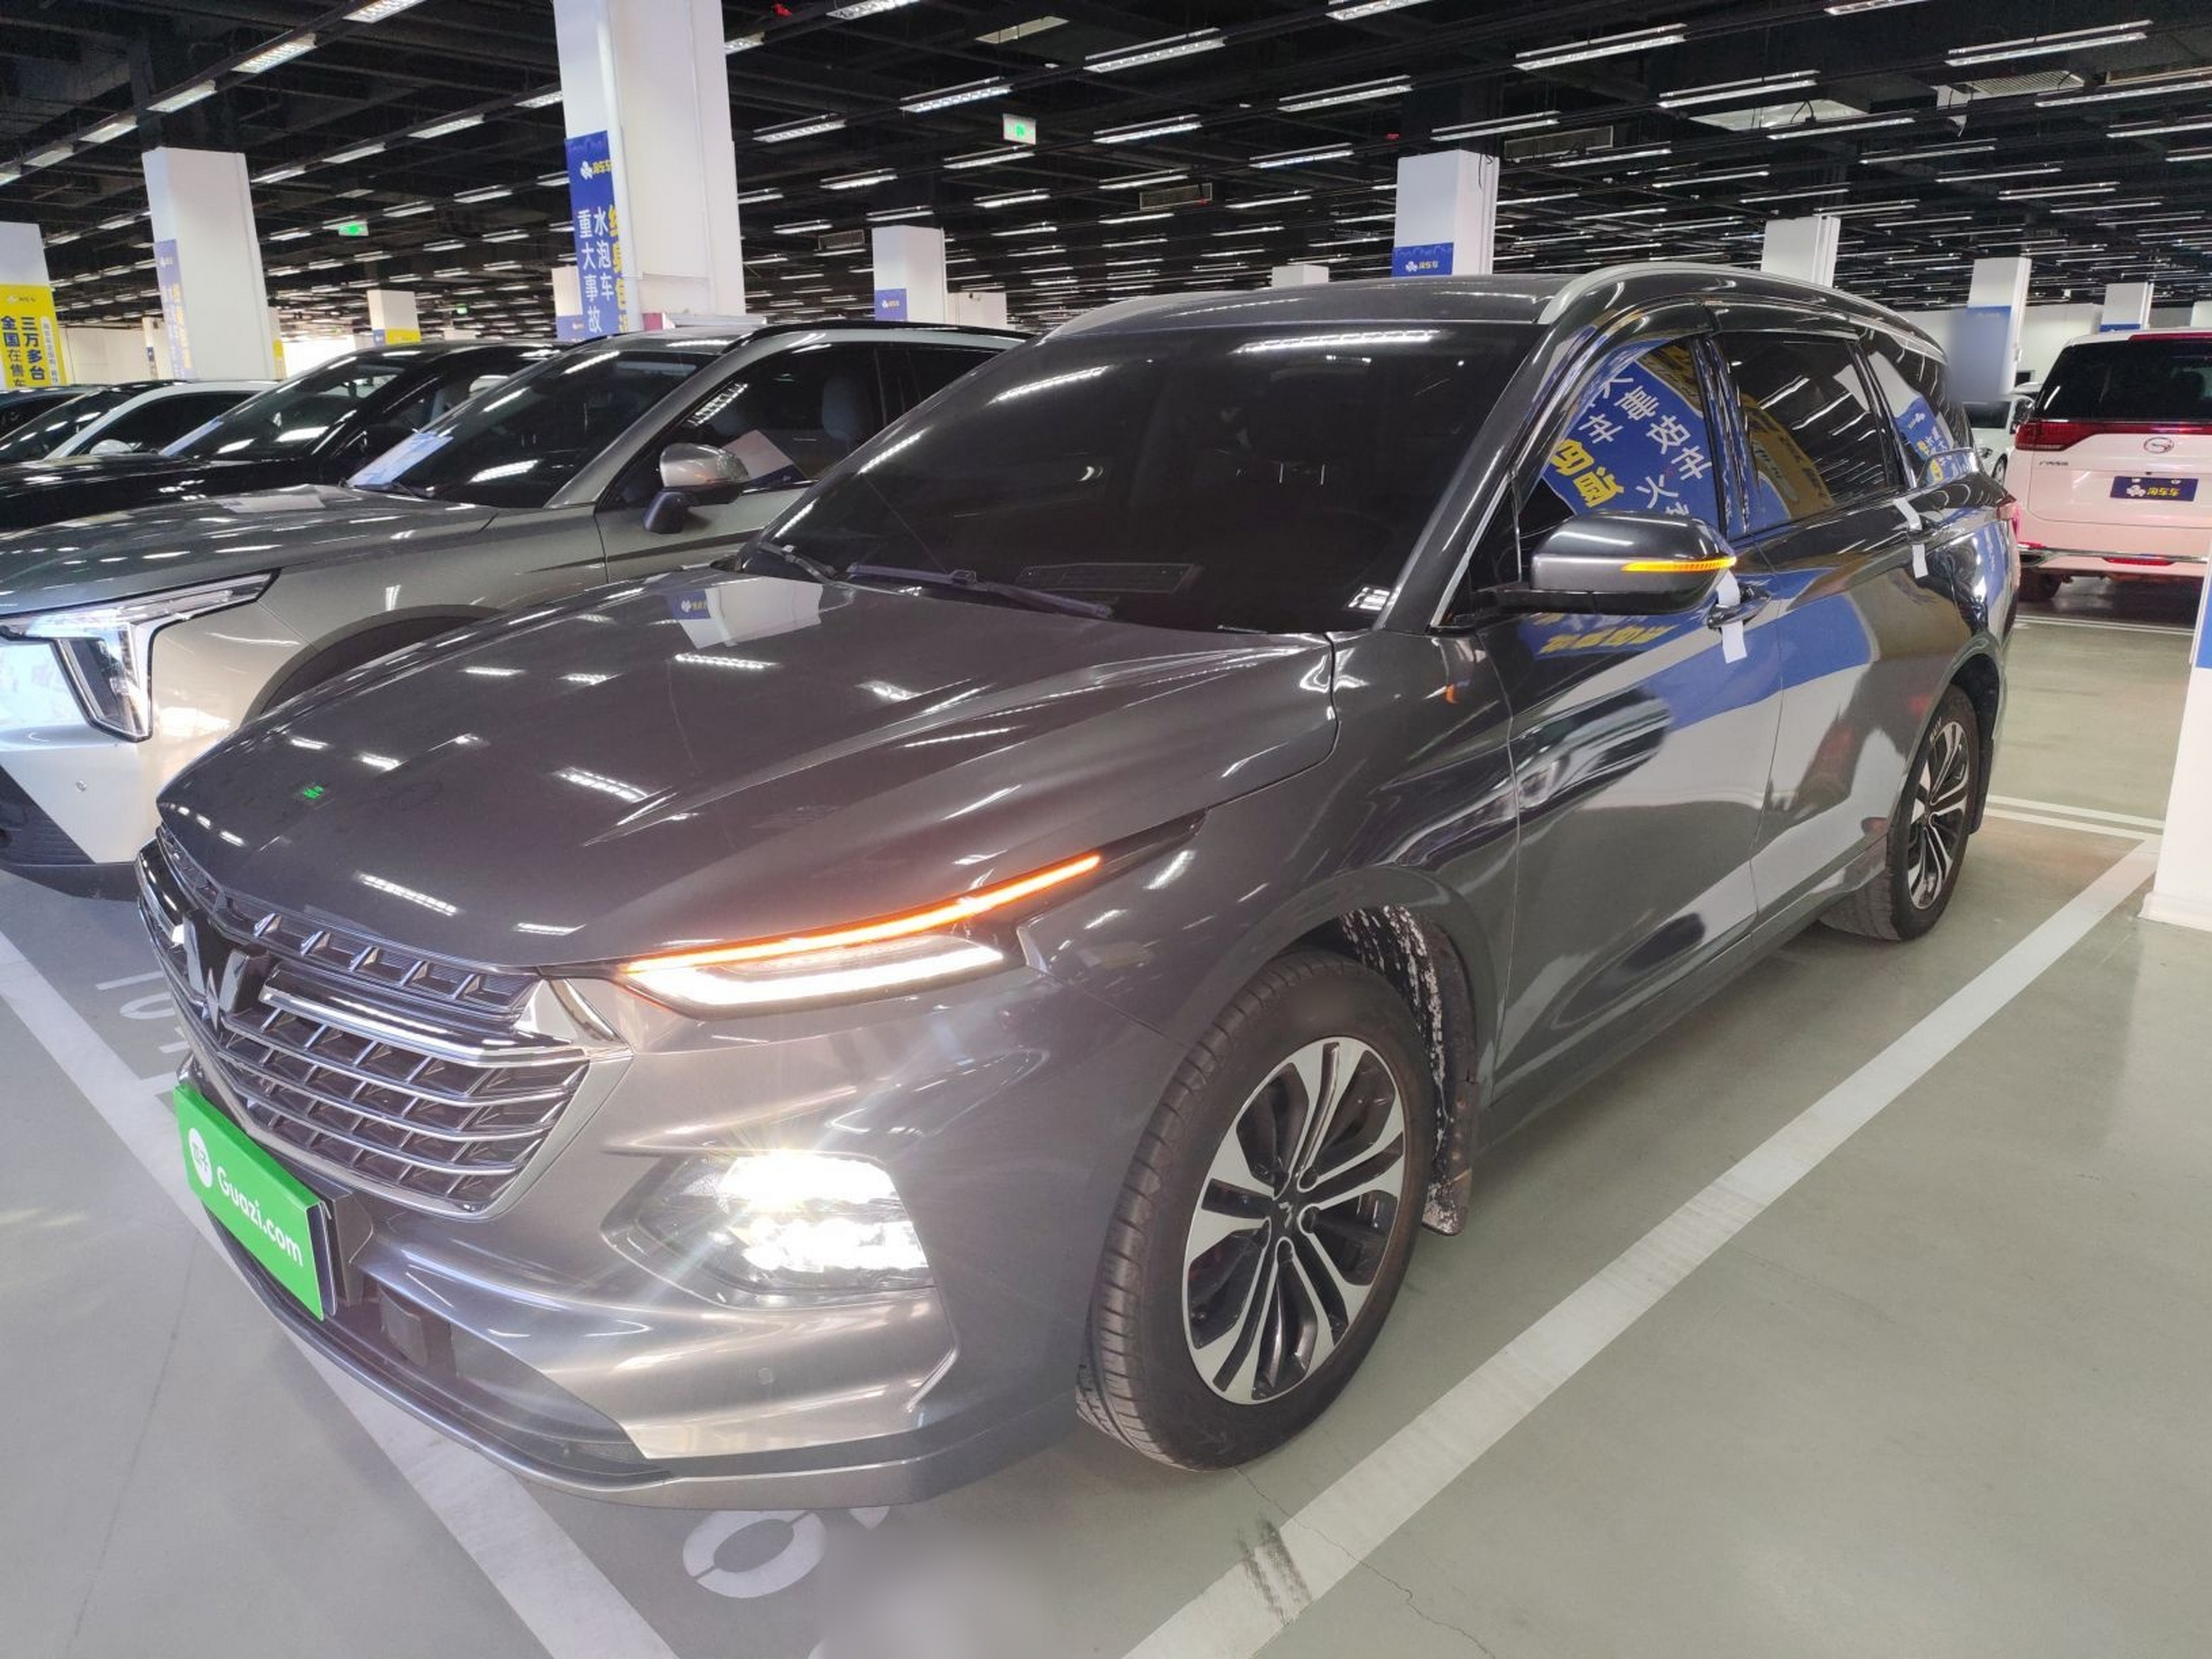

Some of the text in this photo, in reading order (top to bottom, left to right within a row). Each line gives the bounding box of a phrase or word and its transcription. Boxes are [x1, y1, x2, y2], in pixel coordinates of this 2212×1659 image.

[577, 209, 603, 333] 重大事故
[593, 206, 615, 301] 水泡车
[21, 316, 45, 380] 三万多台
[217, 1166, 304, 1267] Guazi.com
